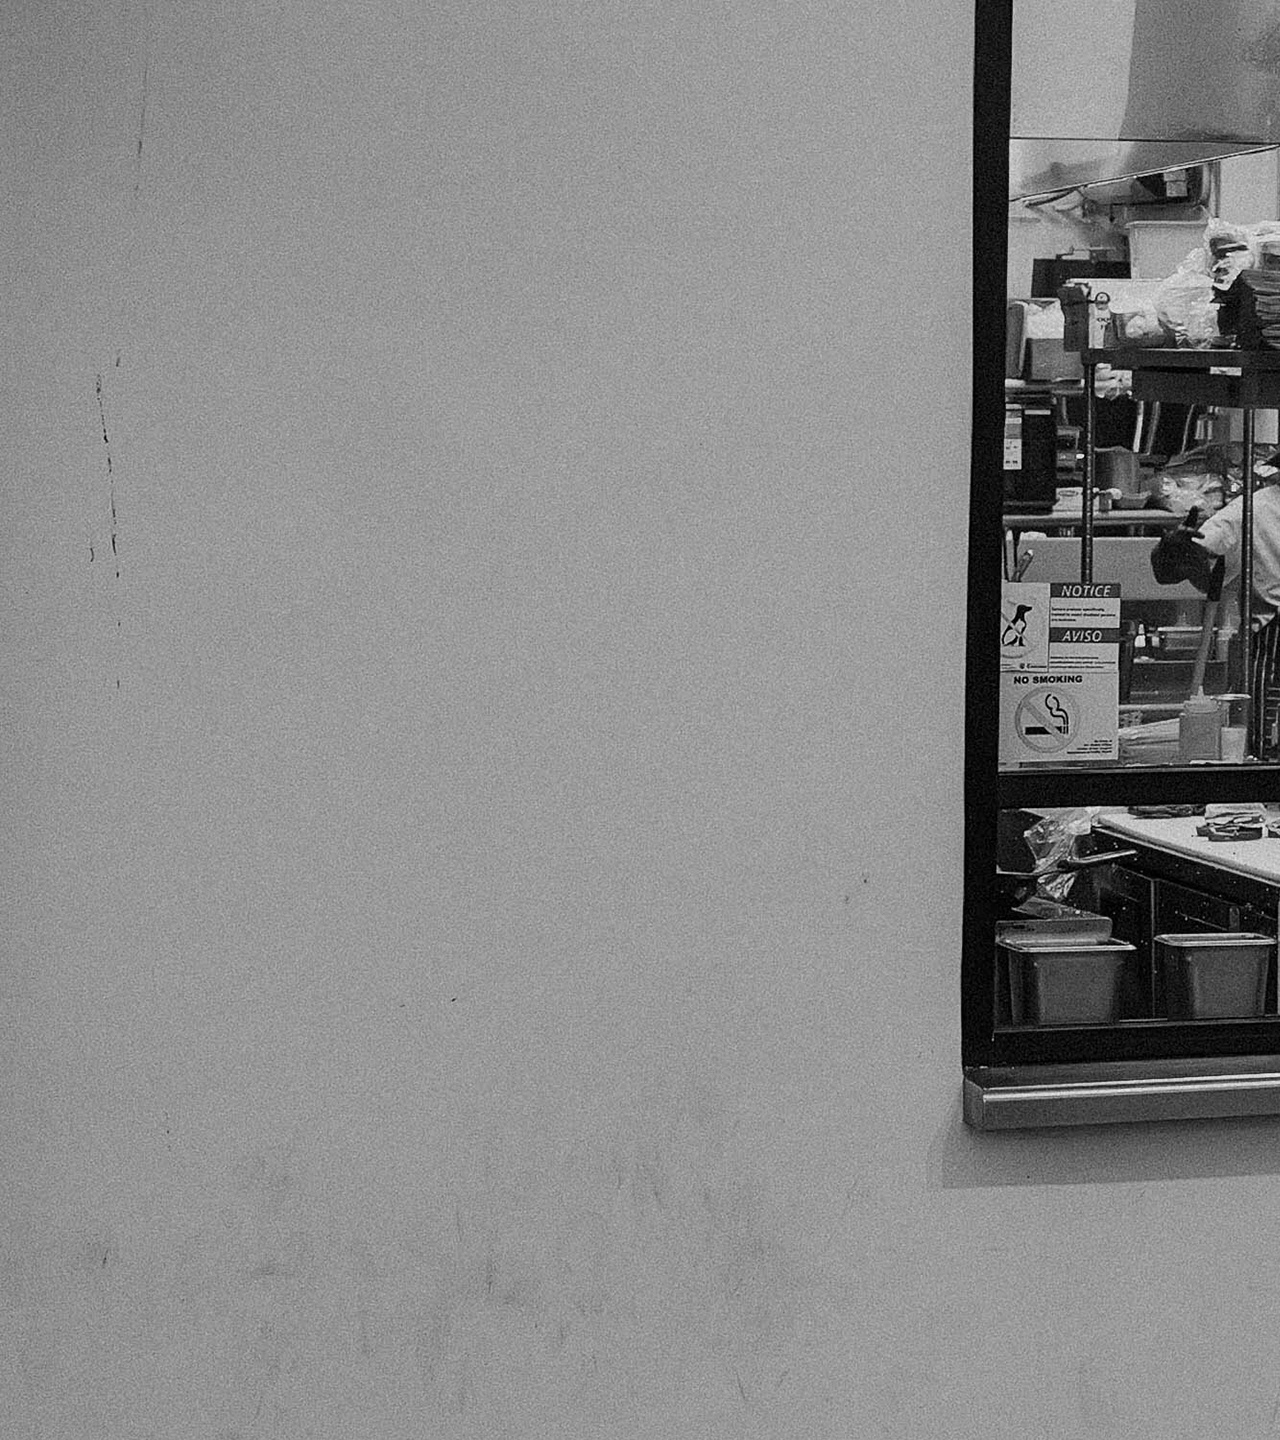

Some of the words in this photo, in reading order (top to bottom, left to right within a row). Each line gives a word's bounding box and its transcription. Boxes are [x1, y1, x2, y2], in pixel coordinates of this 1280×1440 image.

[1061, 585, 1111, 597] NOTICE
[1062, 630, 1102, 642] AVISO
[1014, 675, 1029, 684] NO
[1032, 675, 1083, 684] SMOKING
